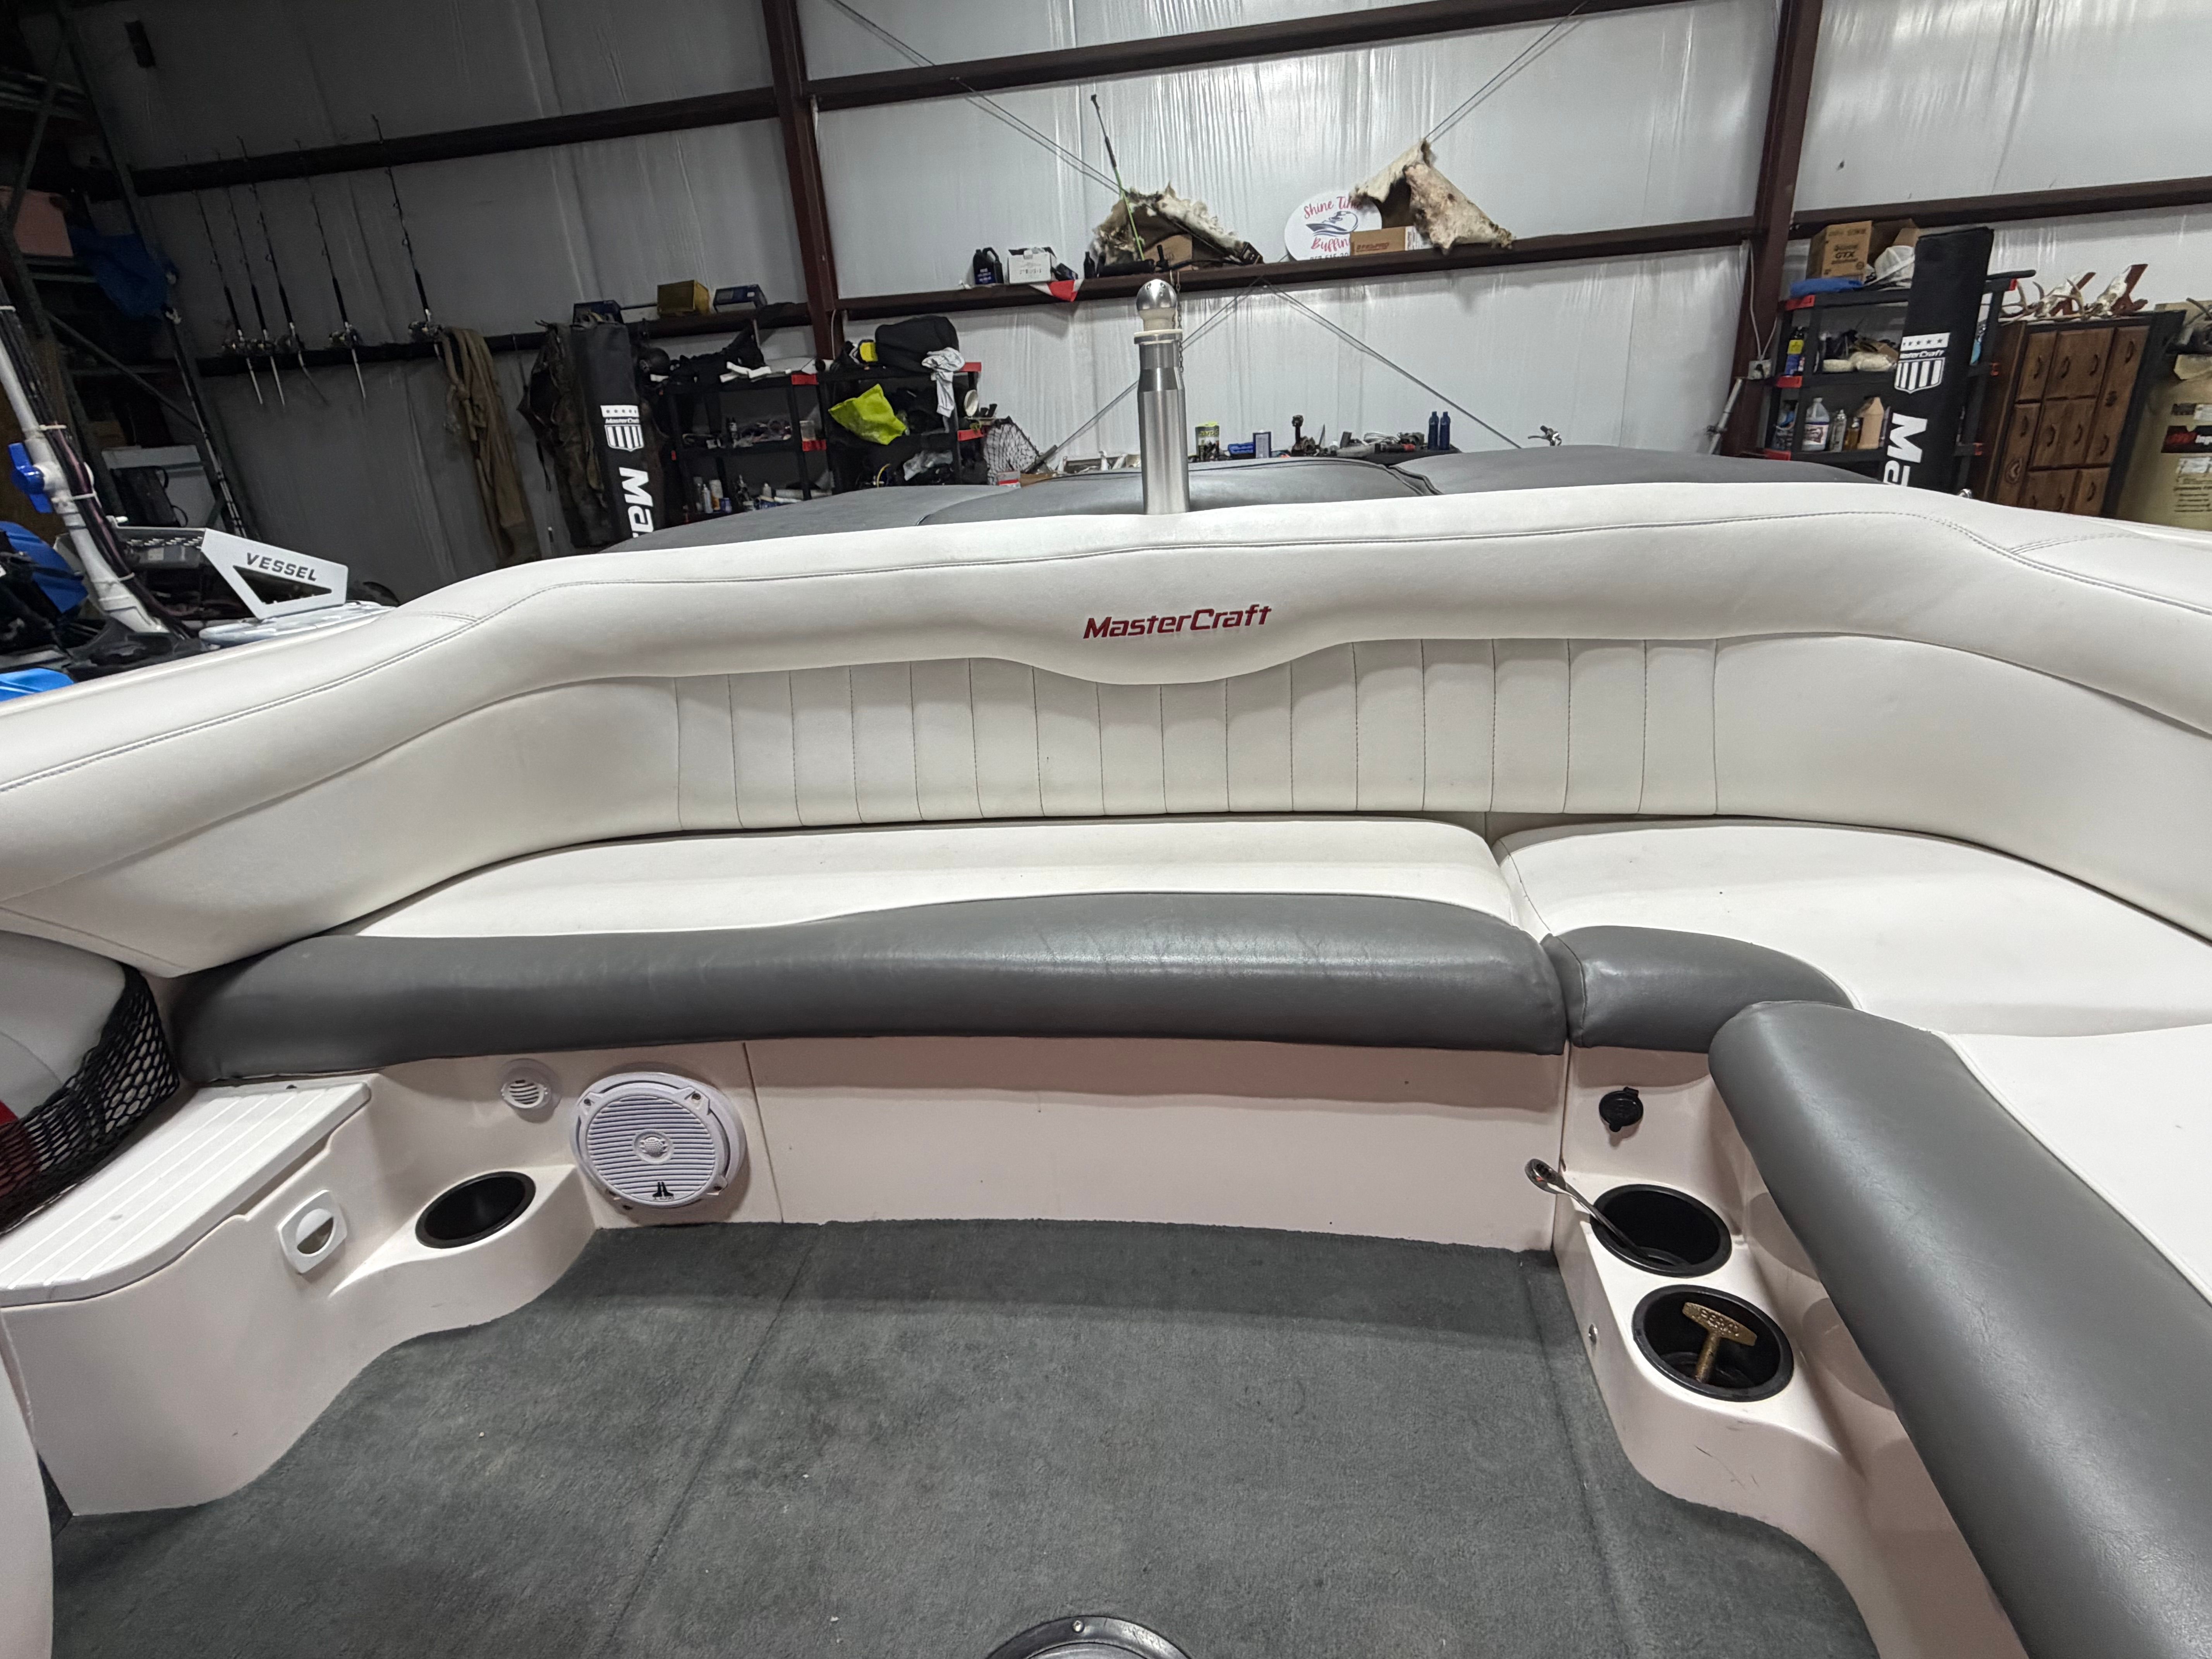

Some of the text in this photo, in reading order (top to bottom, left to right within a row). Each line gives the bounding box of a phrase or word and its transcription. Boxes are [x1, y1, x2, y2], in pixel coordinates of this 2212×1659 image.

[1304, 201, 1334, 219] Shine
[1311, 237, 1349, 252] Buffin
[1883, 412, 1928, 487] Ma
[619, 467, 654, 538] Ma
[247, 552, 317, 581] VESSEL
[1083, 604, 1272, 639] MasterCraft
